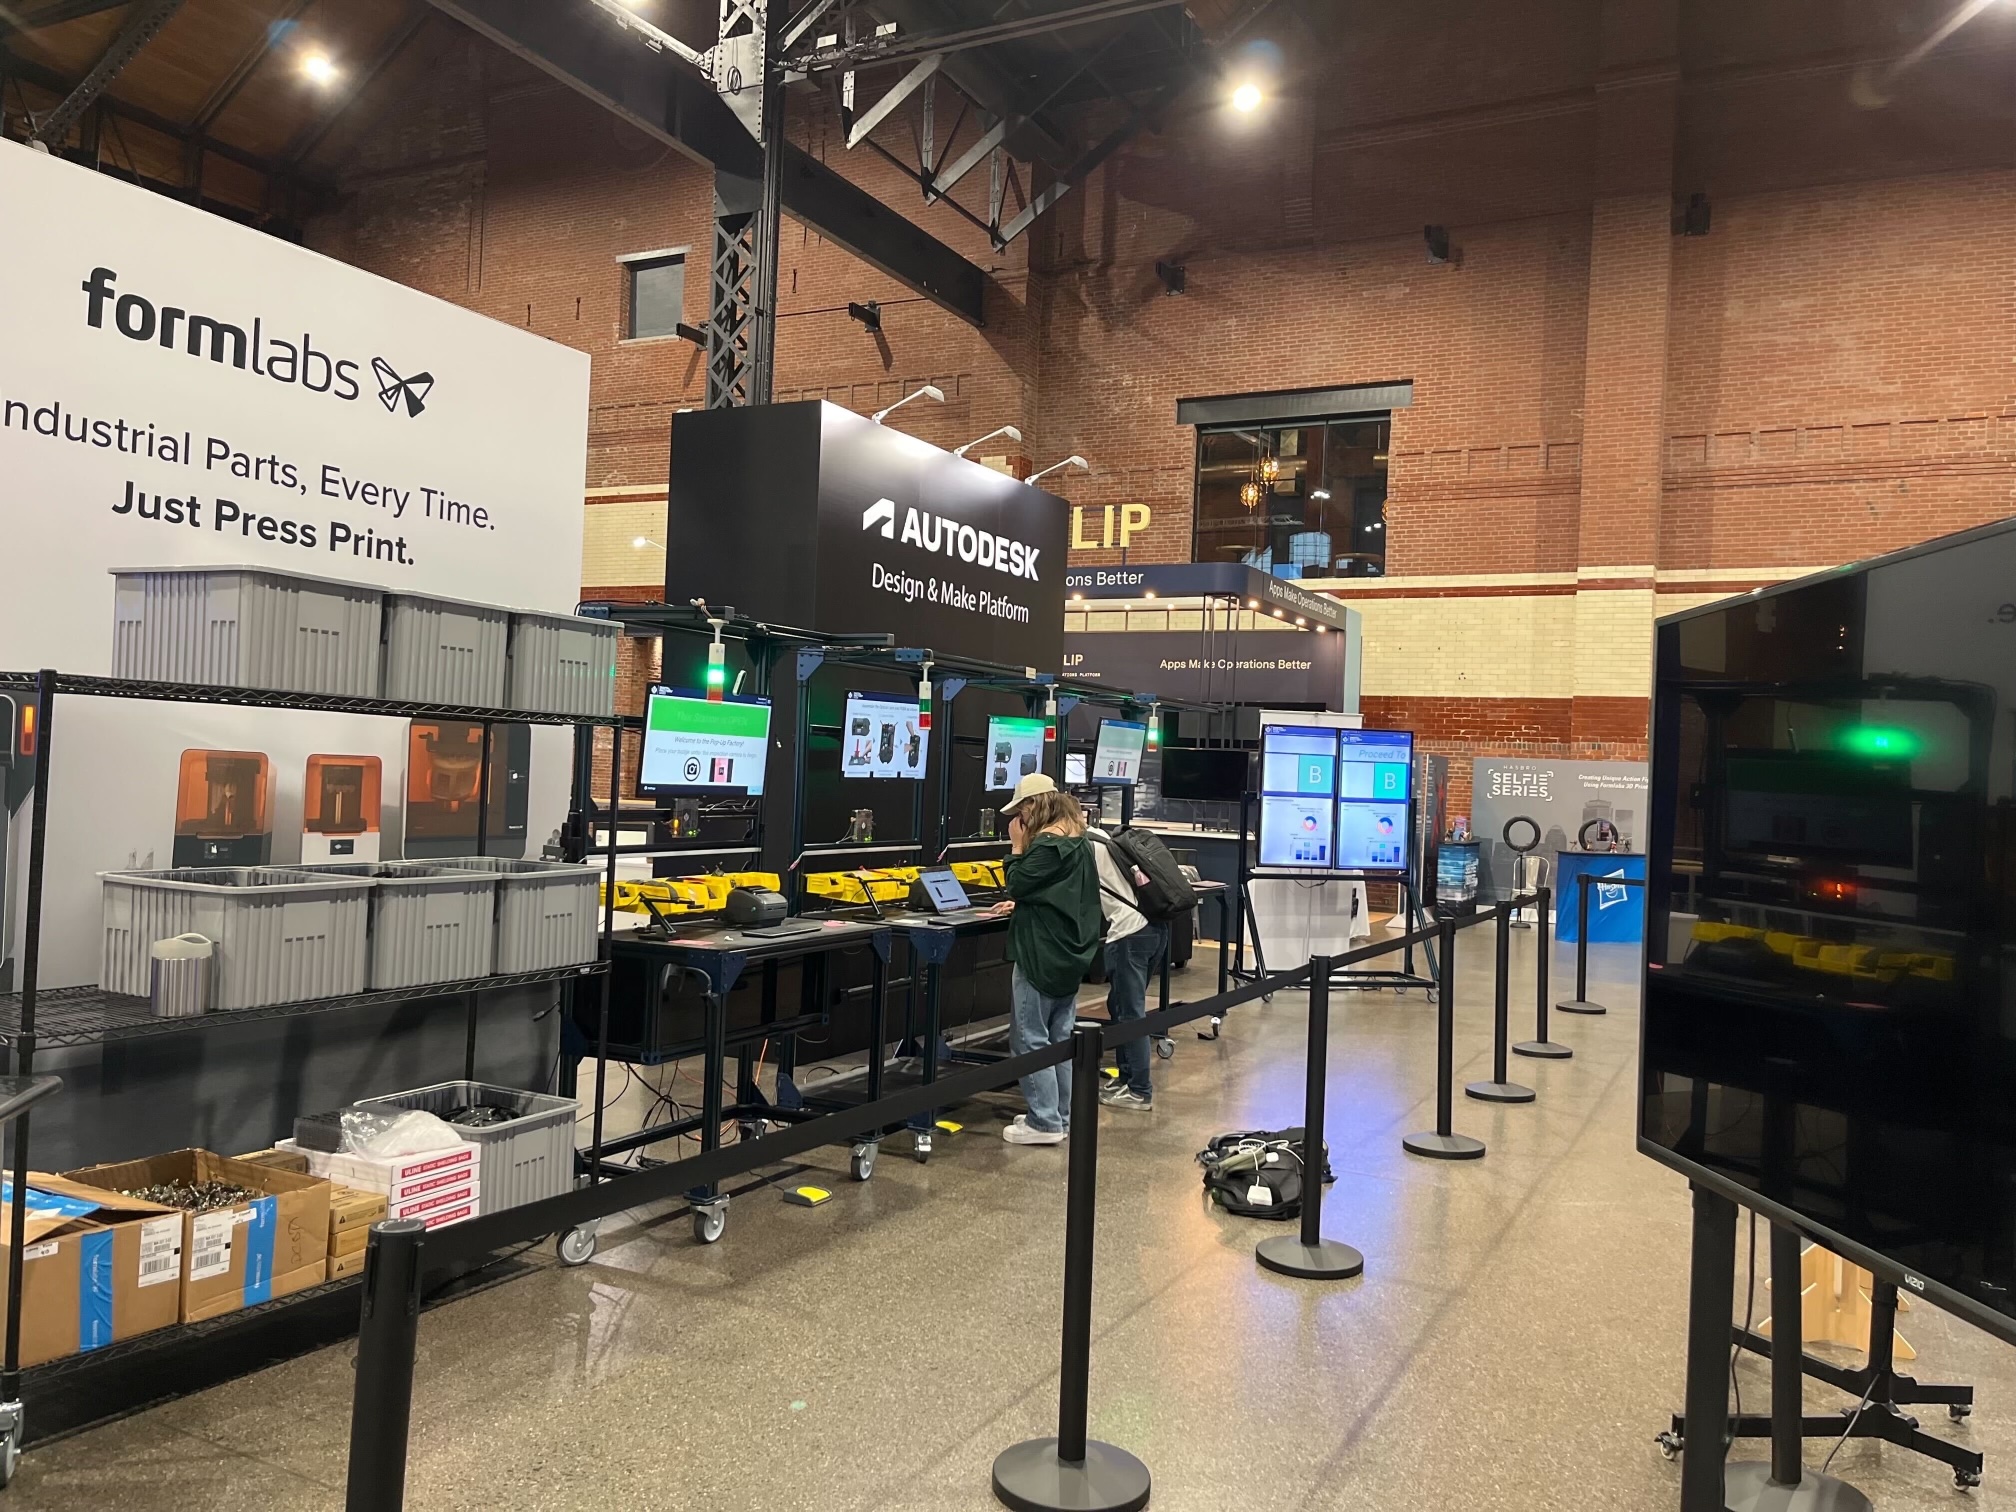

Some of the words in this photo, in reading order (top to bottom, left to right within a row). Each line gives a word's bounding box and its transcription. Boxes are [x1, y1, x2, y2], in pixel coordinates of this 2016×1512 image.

[82, 266, 359, 400] formlabs
[206, 437, 307, 495] Parts,
[321, 465, 410, 518] Every
[420, 486, 495, 530] Time.
[112, 481, 201, 528] Just
[214, 498, 317, 548] Press
[330, 521, 414, 565] Print.
[1072, 504, 1151, 549] LIP
[901, 507, 1040, 581] AUTODESK
[1097, 572, 1144, 585] Better
[872, 563, 923, 602] Design
[928, 578, 938, 602] &
[941, 581, 976, 611] Make
[979, 591, 1028, 623] Platform
[1269, 580, 1283, 598] Apps
[1284, 586, 1297, 603] Make
[1298, 592, 1322, 613] Operations
[1323, 603, 1337, 618] Better
[1064, 654, 1083, 666] LIP
[1160, 659, 1186, 670] Apps
[1218, 659, 1275, 670] Operations
[1278, 660, 1311, 669] Better
[675, 736, 696, 744] Welcome
[710, 739, 726, 747] Pop-Up
[1358, 750, 1393, 760] Proceed
[1396, 751, 1406, 760] To
[1309, 766, 1322, 784] B
[1384, 772, 1396, 790] B
[1492, 773, 1548, 785] SELFIE
[1492, 784, 1548, 797] SERIES
[404, 1166, 421, 1176] ULINE
[404, 1186, 420, 1195] ULINE
[402, 1205, 420, 1215] ULINE
[1904, 1274, 1924, 1290] VIZIO
